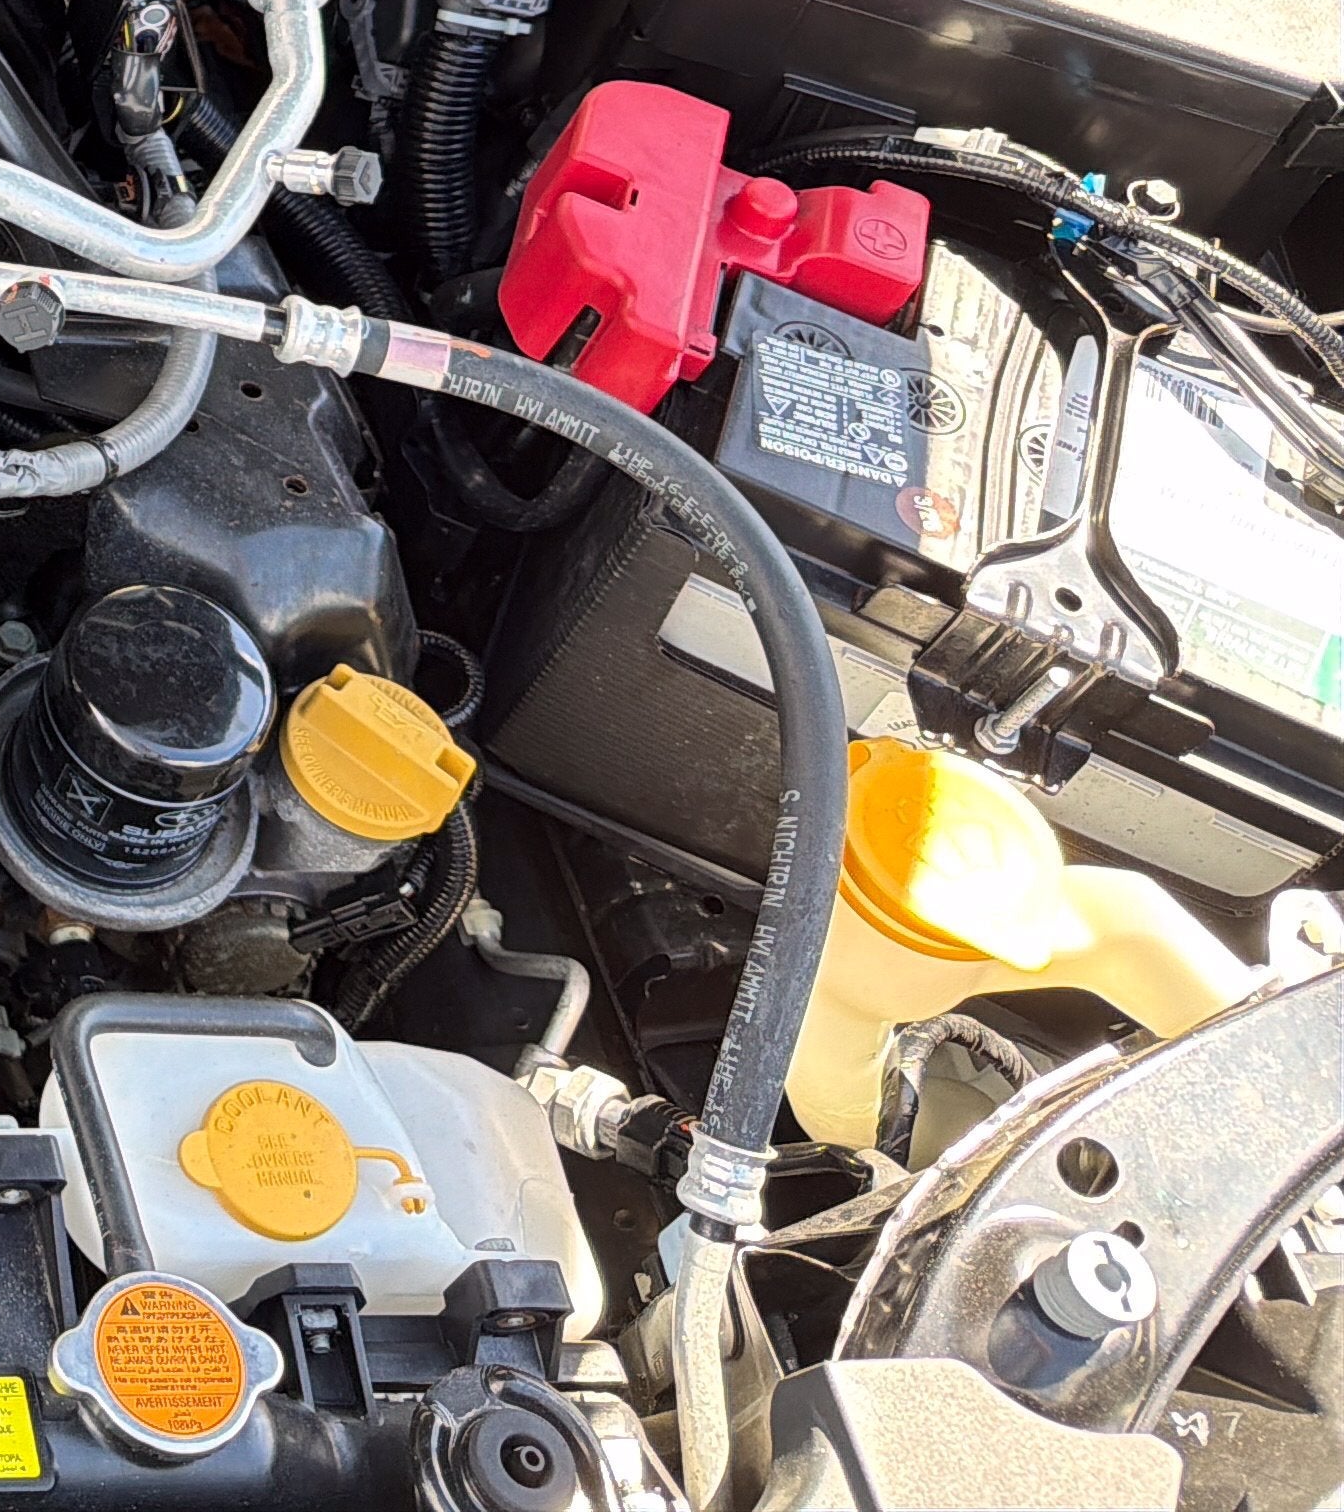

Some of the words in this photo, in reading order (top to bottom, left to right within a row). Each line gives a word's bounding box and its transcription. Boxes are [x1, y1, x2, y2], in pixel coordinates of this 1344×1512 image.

[514, 394, 601, 447] HYLAMMIT
[761, 438, 893, 484] DANGER/POISON
[732, 924, 777, 1024] HYLAMMIT
[214, 1087, 330, 1134] COOLANT
[140, 1300, 197, 1311] WARNING
[108, 1345, 140, 1355] NEVER
[143, 1345, 169, 1354] OPEN
[172, 1345, 202, 1354] WHEN
